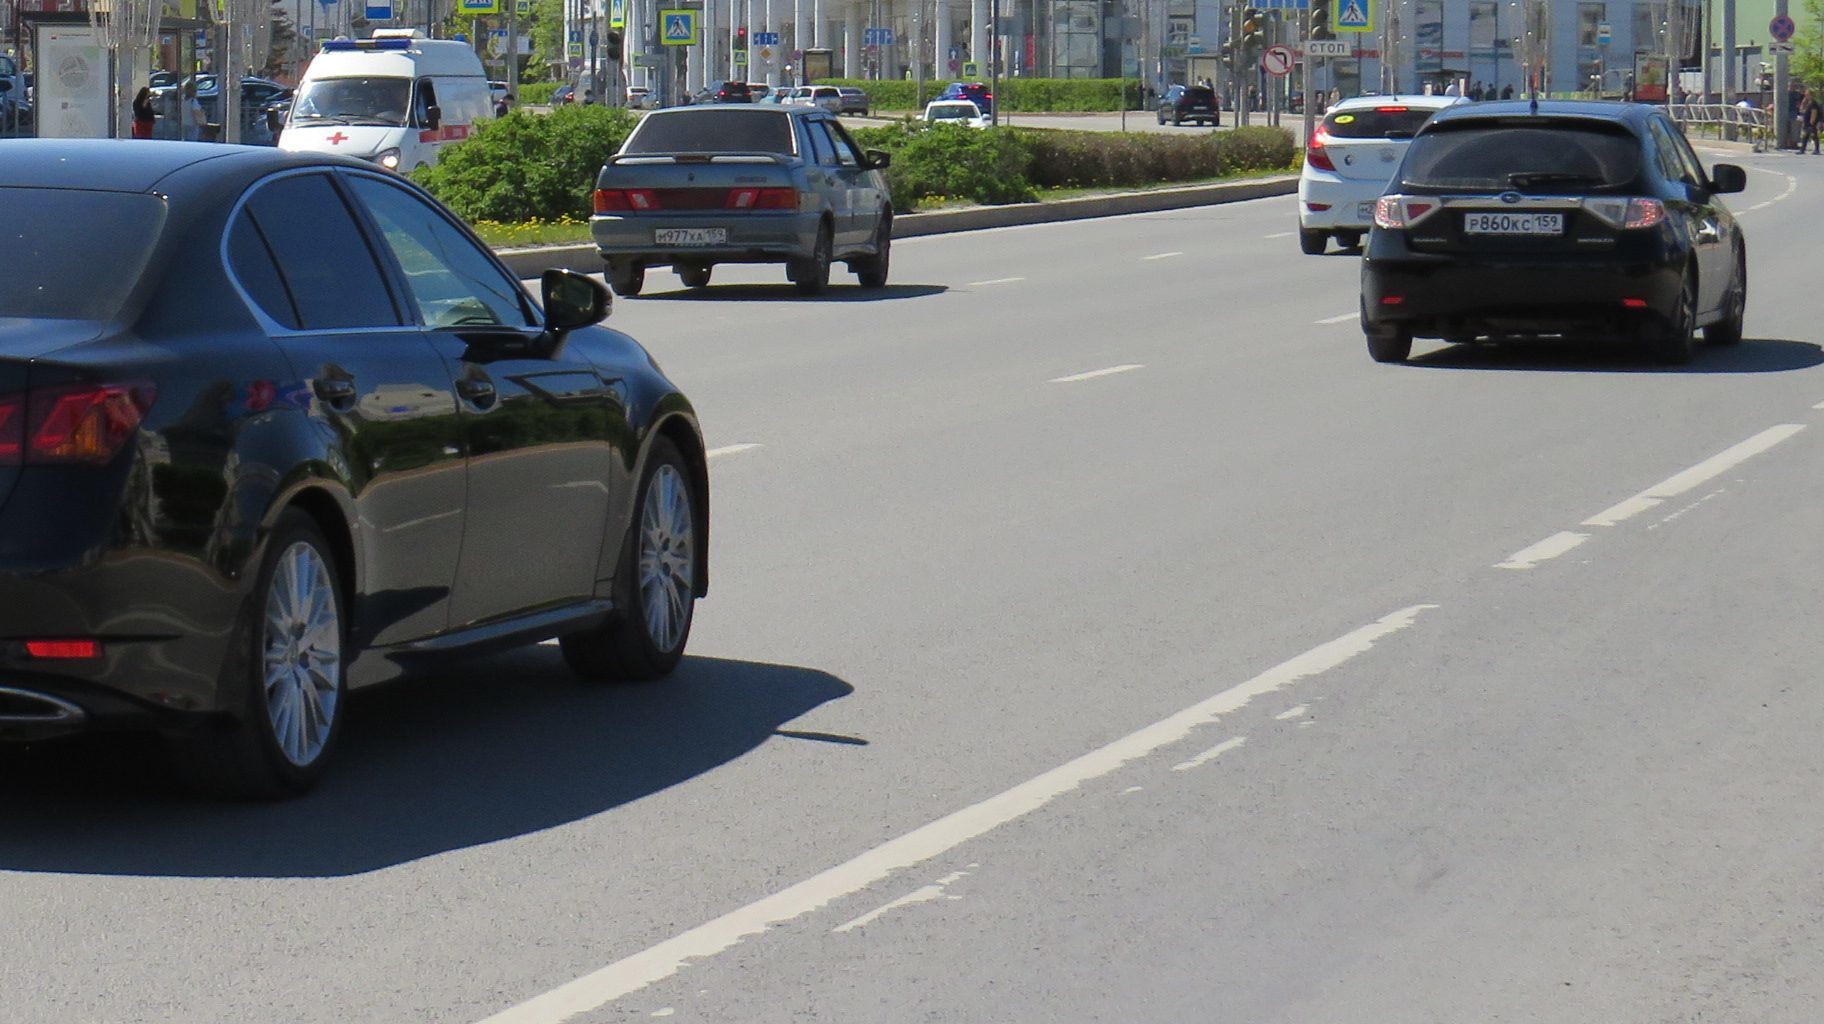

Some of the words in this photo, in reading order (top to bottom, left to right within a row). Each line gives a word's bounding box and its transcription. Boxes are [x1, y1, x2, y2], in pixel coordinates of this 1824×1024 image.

[1310, 43, 1345, 54] СТОП
[1469, 215, 1530, 231] Р860КС
[1536, 215, 1559, 227] 159
[657, 231, 703, 242] М977ХА
